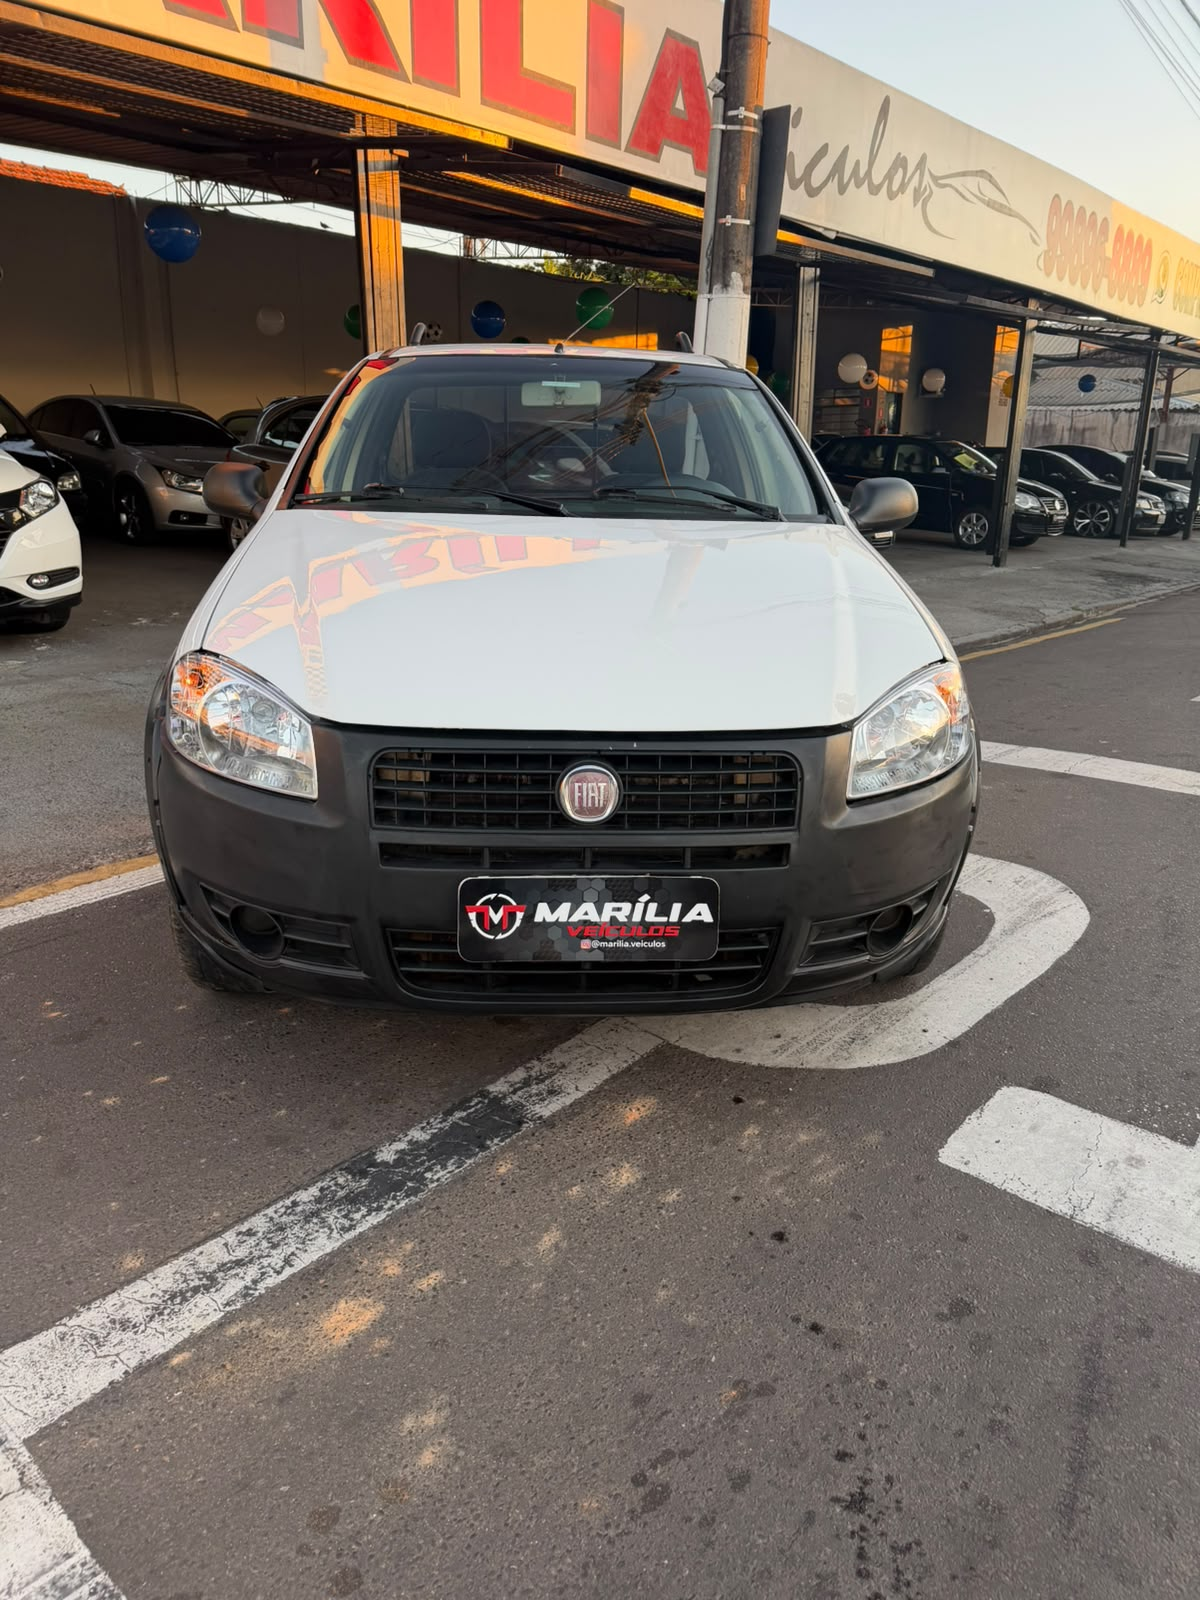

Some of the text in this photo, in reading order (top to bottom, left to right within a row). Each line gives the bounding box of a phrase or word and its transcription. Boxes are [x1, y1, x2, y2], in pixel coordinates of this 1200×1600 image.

[574, 782, 607, 808] FIAT
[533, 893, 714, 923] MARÍLIA
[566, 922, 681, 937] VEÍCULOS
[591, 939, 667, 949] @marilia.veiculos
